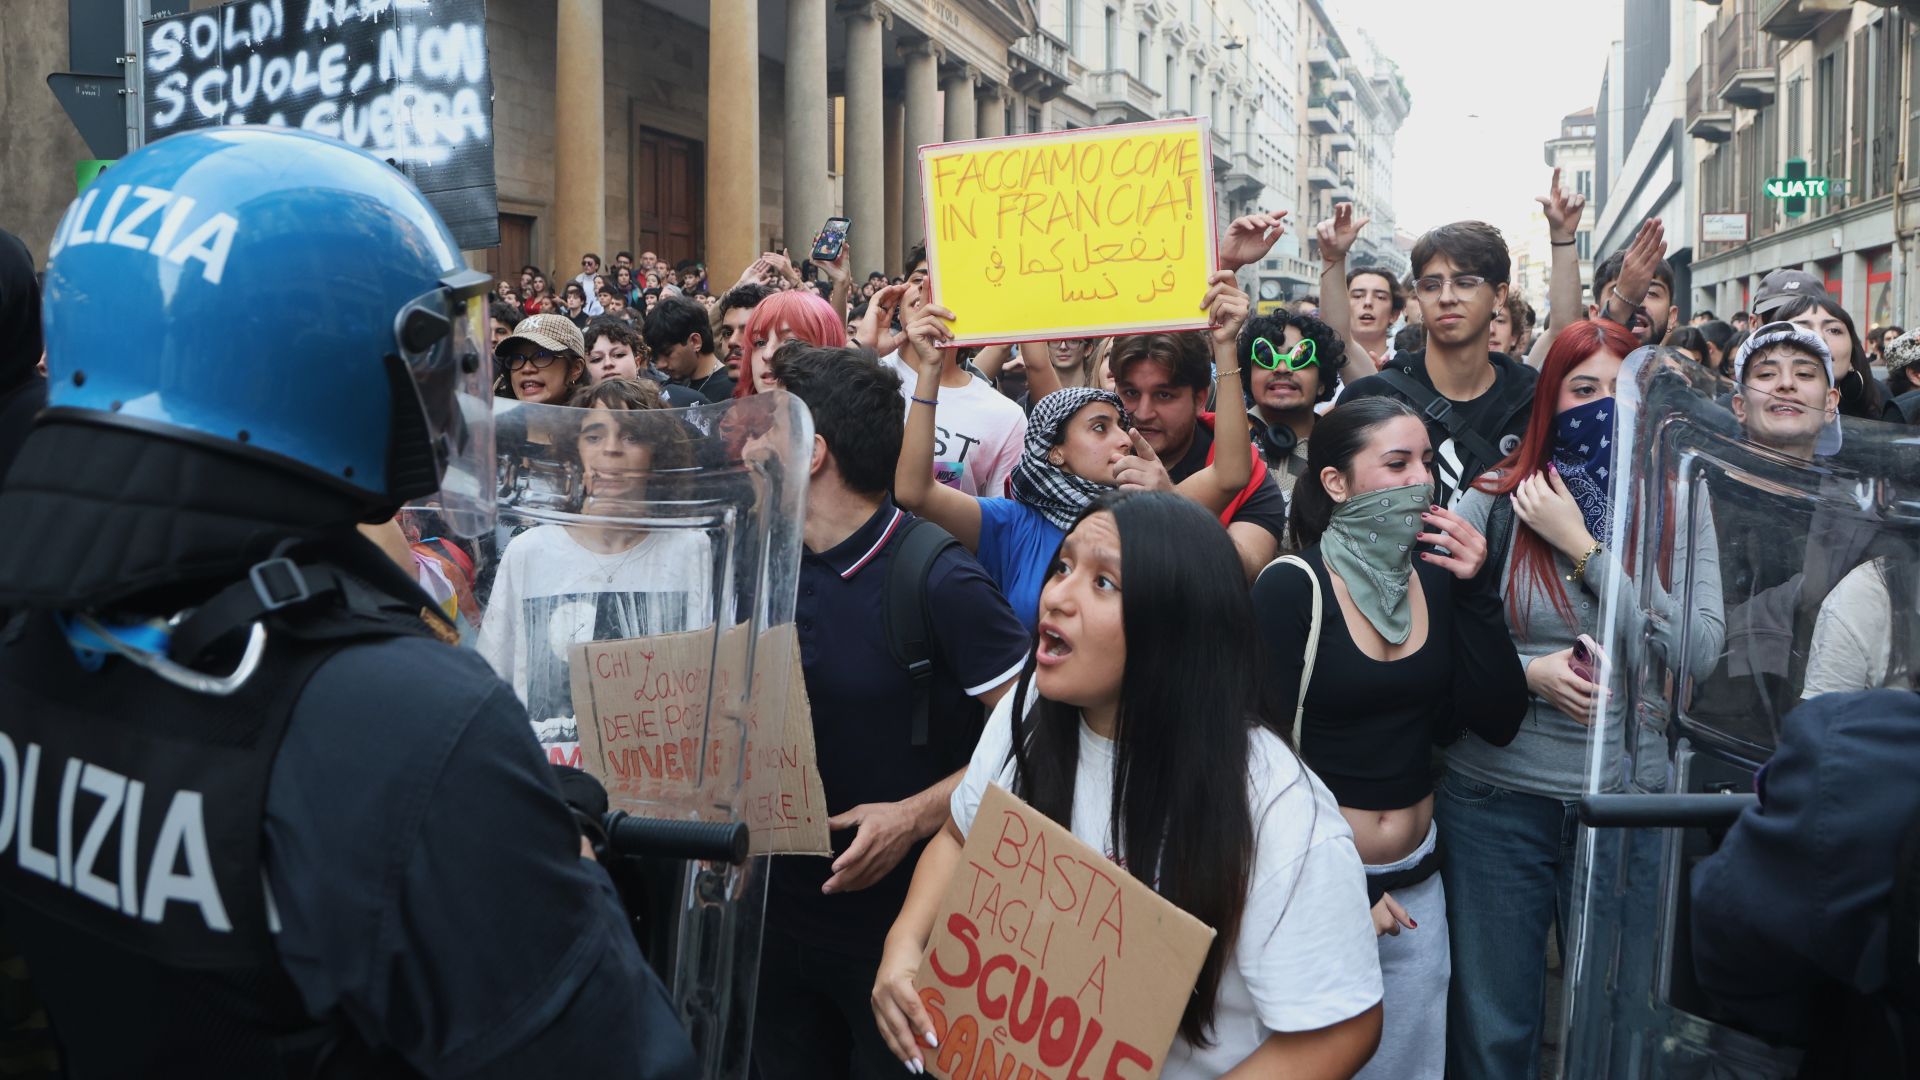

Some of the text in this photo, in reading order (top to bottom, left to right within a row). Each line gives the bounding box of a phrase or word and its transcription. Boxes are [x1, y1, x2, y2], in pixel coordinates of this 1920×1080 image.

[149, 0, 284, 71] SOLDI
[152, 22, 486, 128] SCUOLE, NON
[934, 138, 1198, 197] FACCIAMO COME
[941, 176, 1193, 241] IN FRANCIA!
[936, 470, 957, 480] NIKE
[596, 651, 630, 679] CHI
[604, 710, 659, 742] DEVE
[993, 810, 1122, 958] BASTA
[969, 860, 1106, 1014] TAGLI A
